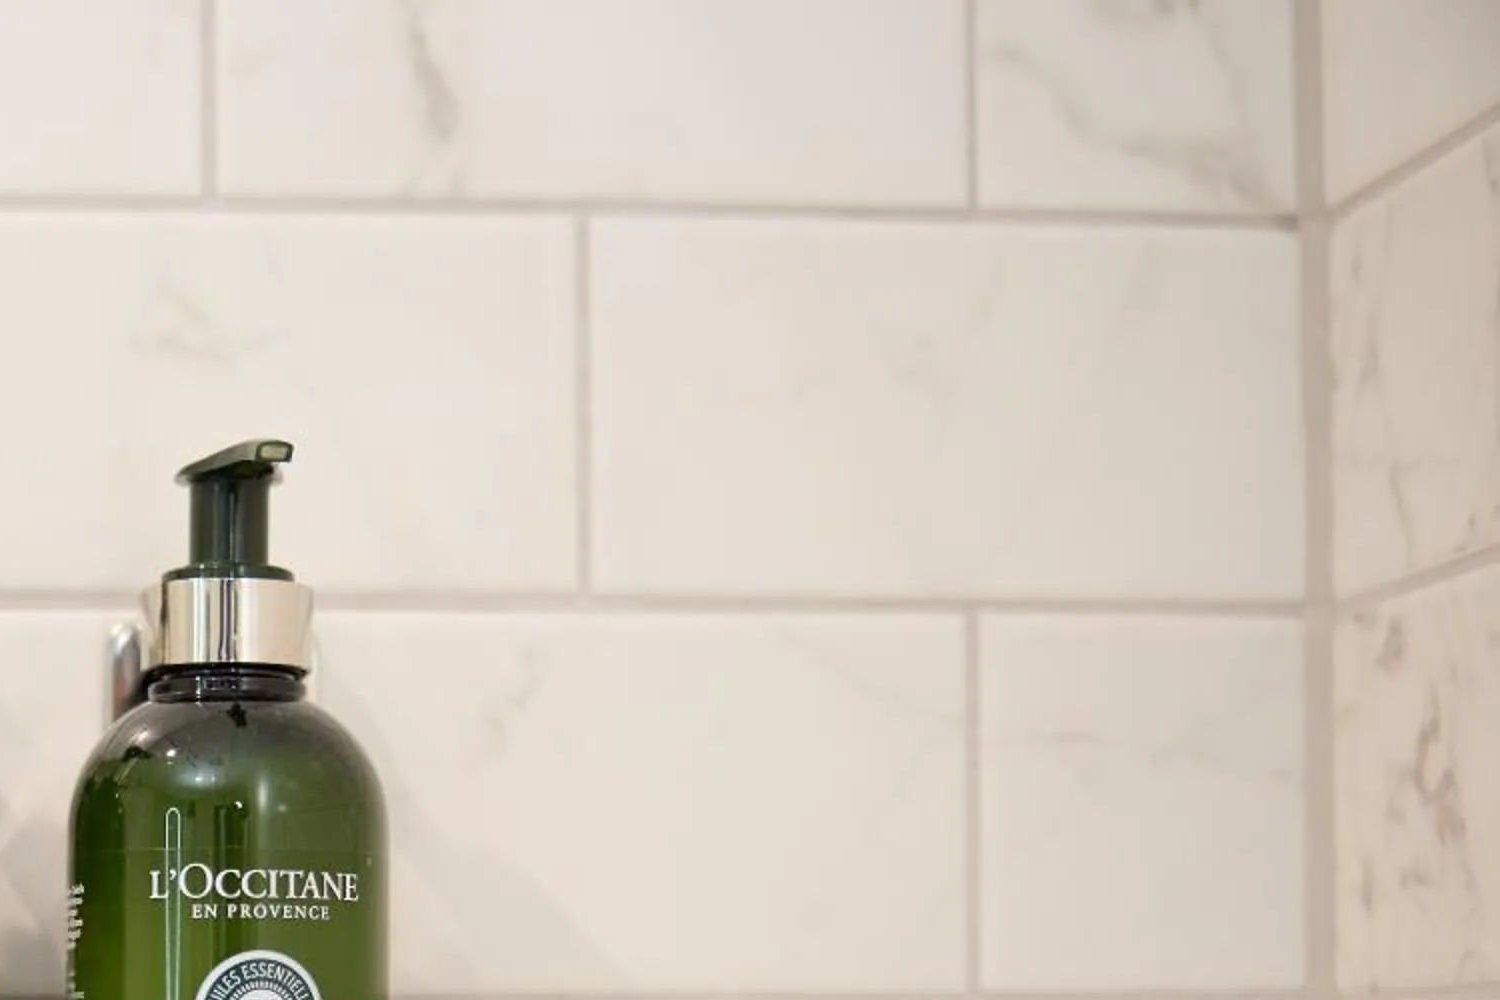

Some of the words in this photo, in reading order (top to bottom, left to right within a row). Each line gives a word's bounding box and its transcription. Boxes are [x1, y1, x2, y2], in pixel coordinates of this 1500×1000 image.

[150, 863, 359, 901] L'OCCITANE
[191, 904, 218, 919] EN
[227, 904, 330, 920] PROVENCE
